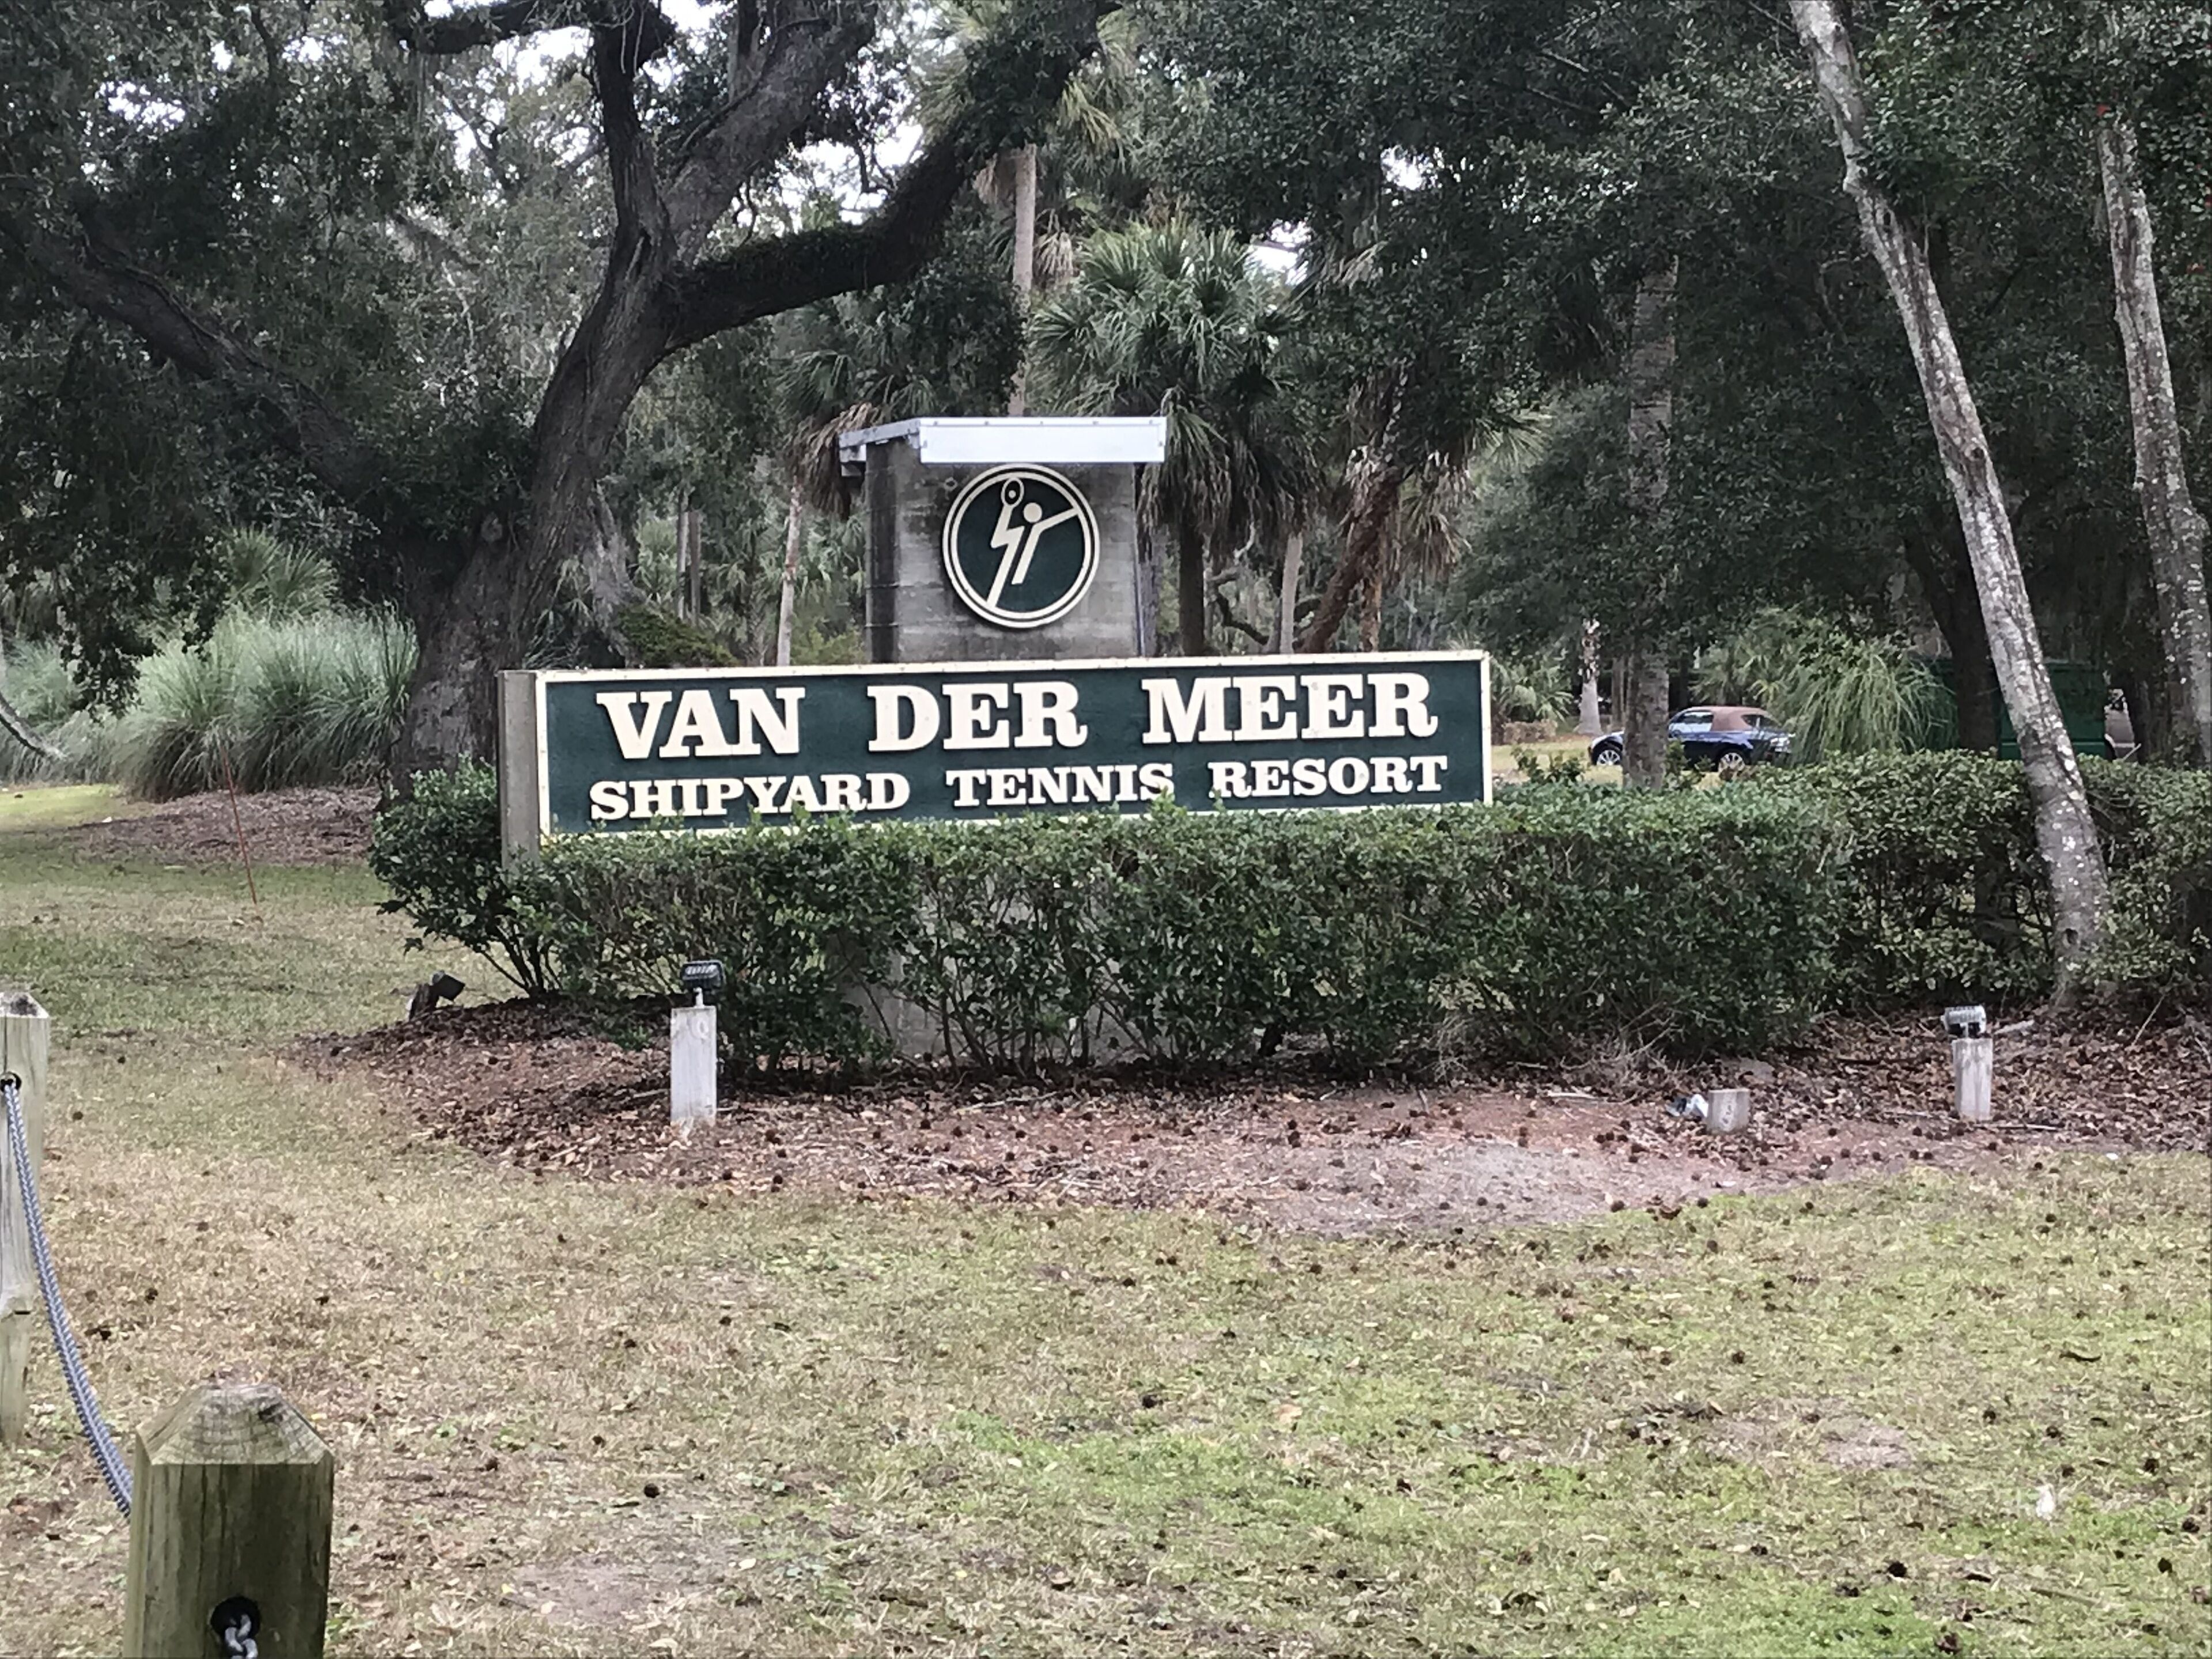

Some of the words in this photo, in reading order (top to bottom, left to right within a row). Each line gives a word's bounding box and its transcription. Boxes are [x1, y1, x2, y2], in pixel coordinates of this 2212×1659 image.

[596, 687, 805, 759] VAN
[868, 682, 1088, 752] DER
[1142, 672, 1438, 744] MEER
[589, 772, 910, 820] SHIPYARD
[946, 763, 1175, 806] TENNIS
[1207, 755, 1448, 798] RESORT
